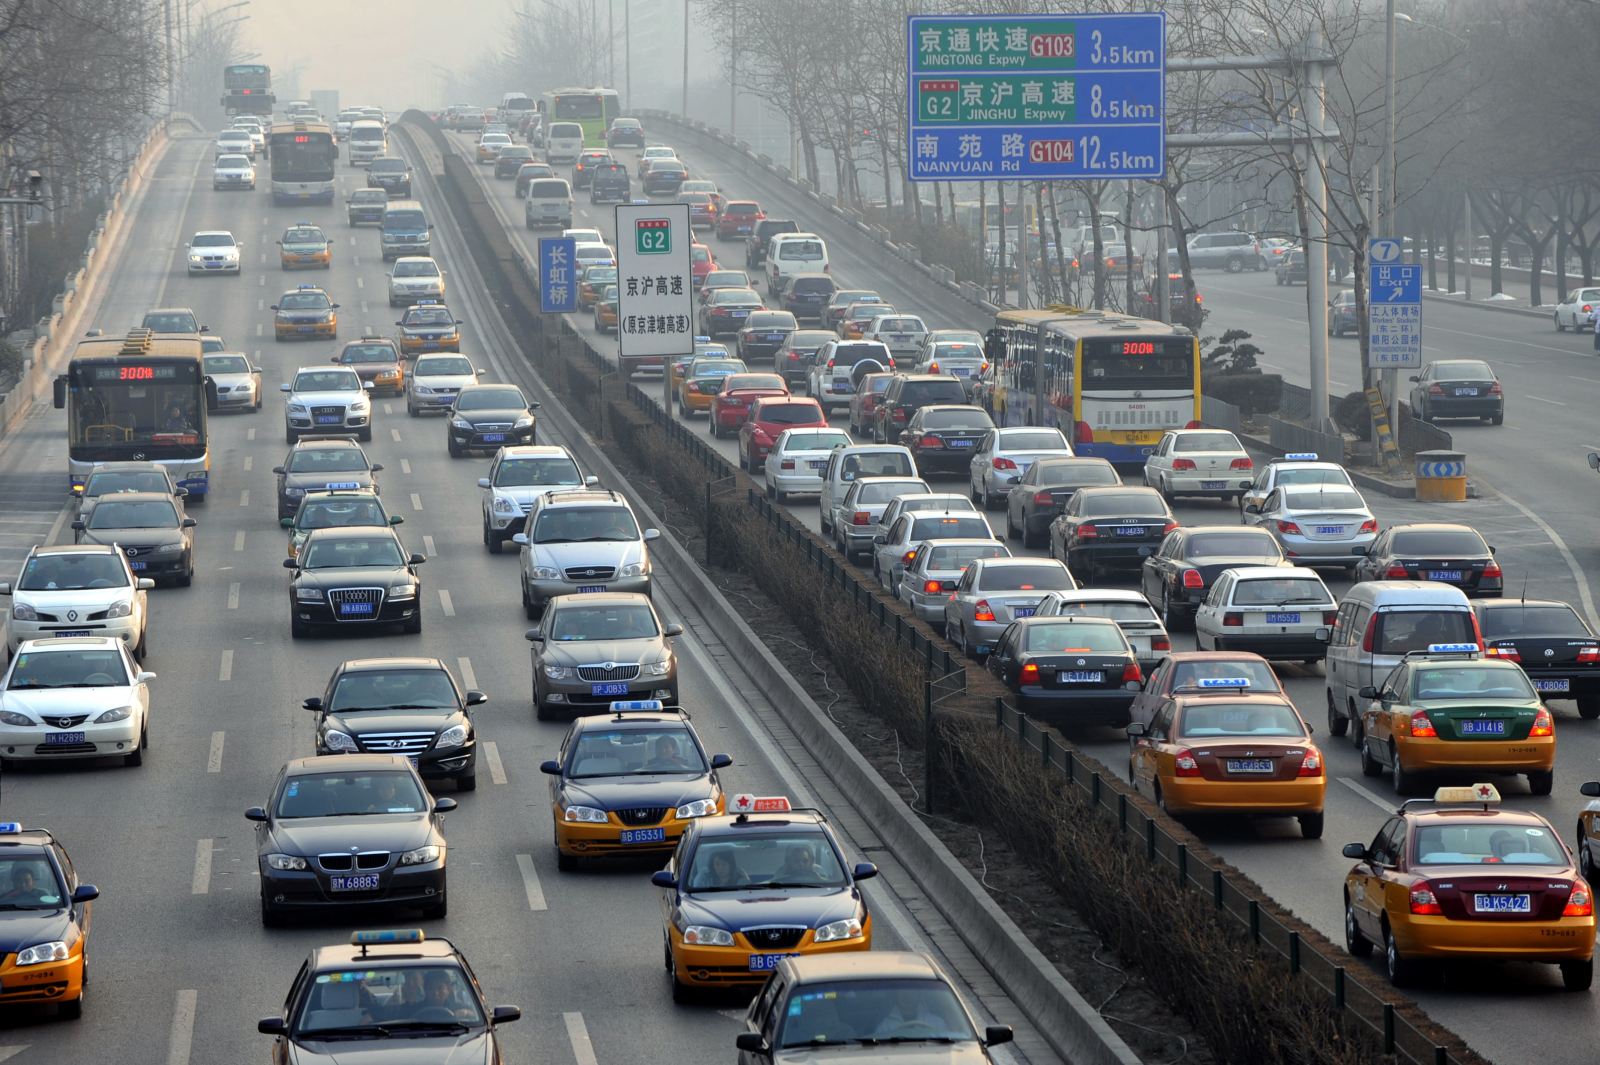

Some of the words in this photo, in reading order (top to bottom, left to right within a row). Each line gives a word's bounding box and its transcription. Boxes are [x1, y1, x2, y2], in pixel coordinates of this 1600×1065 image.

[919, 27, 1028, 52] 京通快速
[1031, 35, 1073, 57] G103
[922, 54, 983, 65] JINGTONG
[989, 53, 1026, 67] Expwy
[961, 81, 1076, 106] 京沪高速
[966, 109, 1017, 120] JINGHU
[1024, 108, 1066, 121] Expwy
[916, 133, 1025, 159] 南苑路
[1030, 141, 1073, 162] G104
[917, 160, 993, 173] NANYUAN
[1001, 160, 1020, 171] Rd
[642, 231, 665, 250] G2
[1380, 242, 1391, 260] 7
[548, 245, 569, 305] 长虹桥
[1380, 266, 1412, 280] 出口
[626, 276, 683, 297] 京沪高速
[1371, 306, 1419, 317] 工人体育场
[622, 314, 690, 335] (原京津塘高速)
[1371, 334, 1419, 345] 朝阳公园桥
